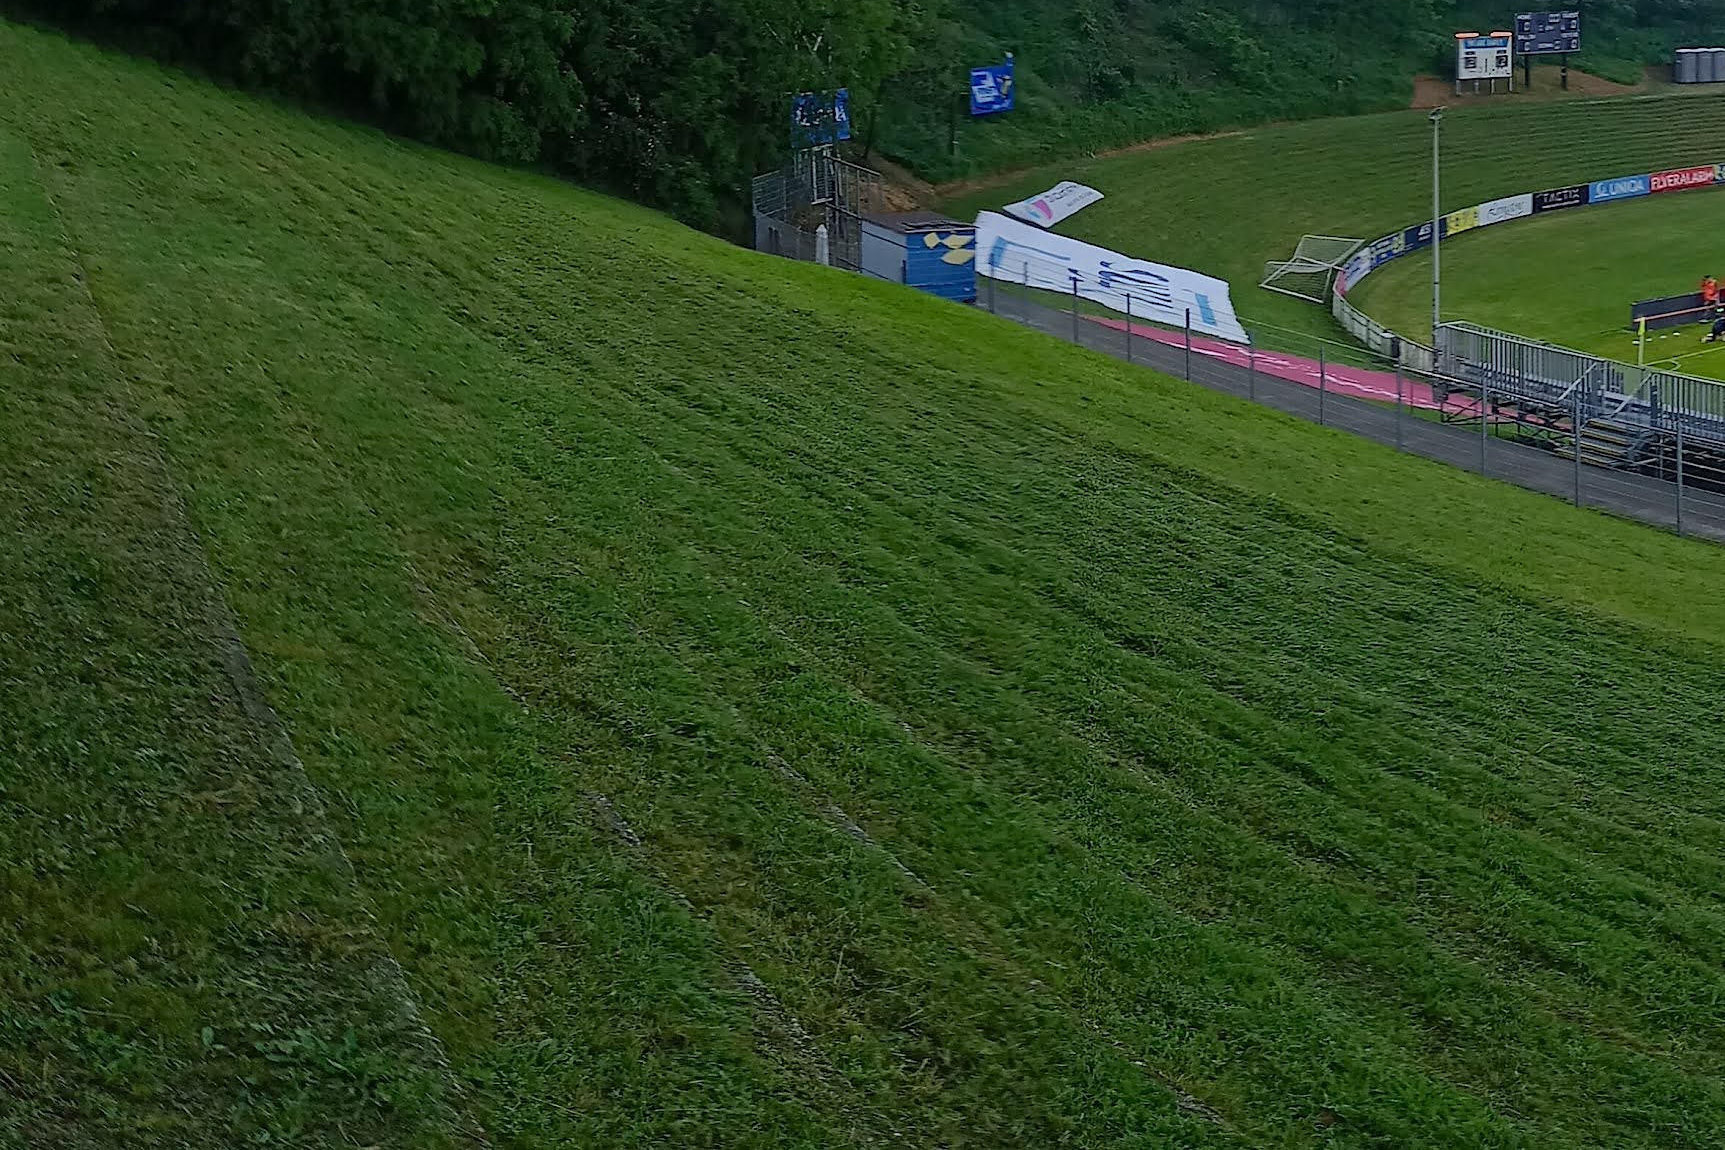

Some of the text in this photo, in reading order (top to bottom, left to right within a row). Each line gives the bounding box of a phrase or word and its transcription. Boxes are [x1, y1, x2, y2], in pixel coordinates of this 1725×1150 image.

[1609, 179, 1645, 196] UNIQA
[1651, 170, 1715, 191] FLYERALARM
[1543, 188, 1580, 203] TACTIX
